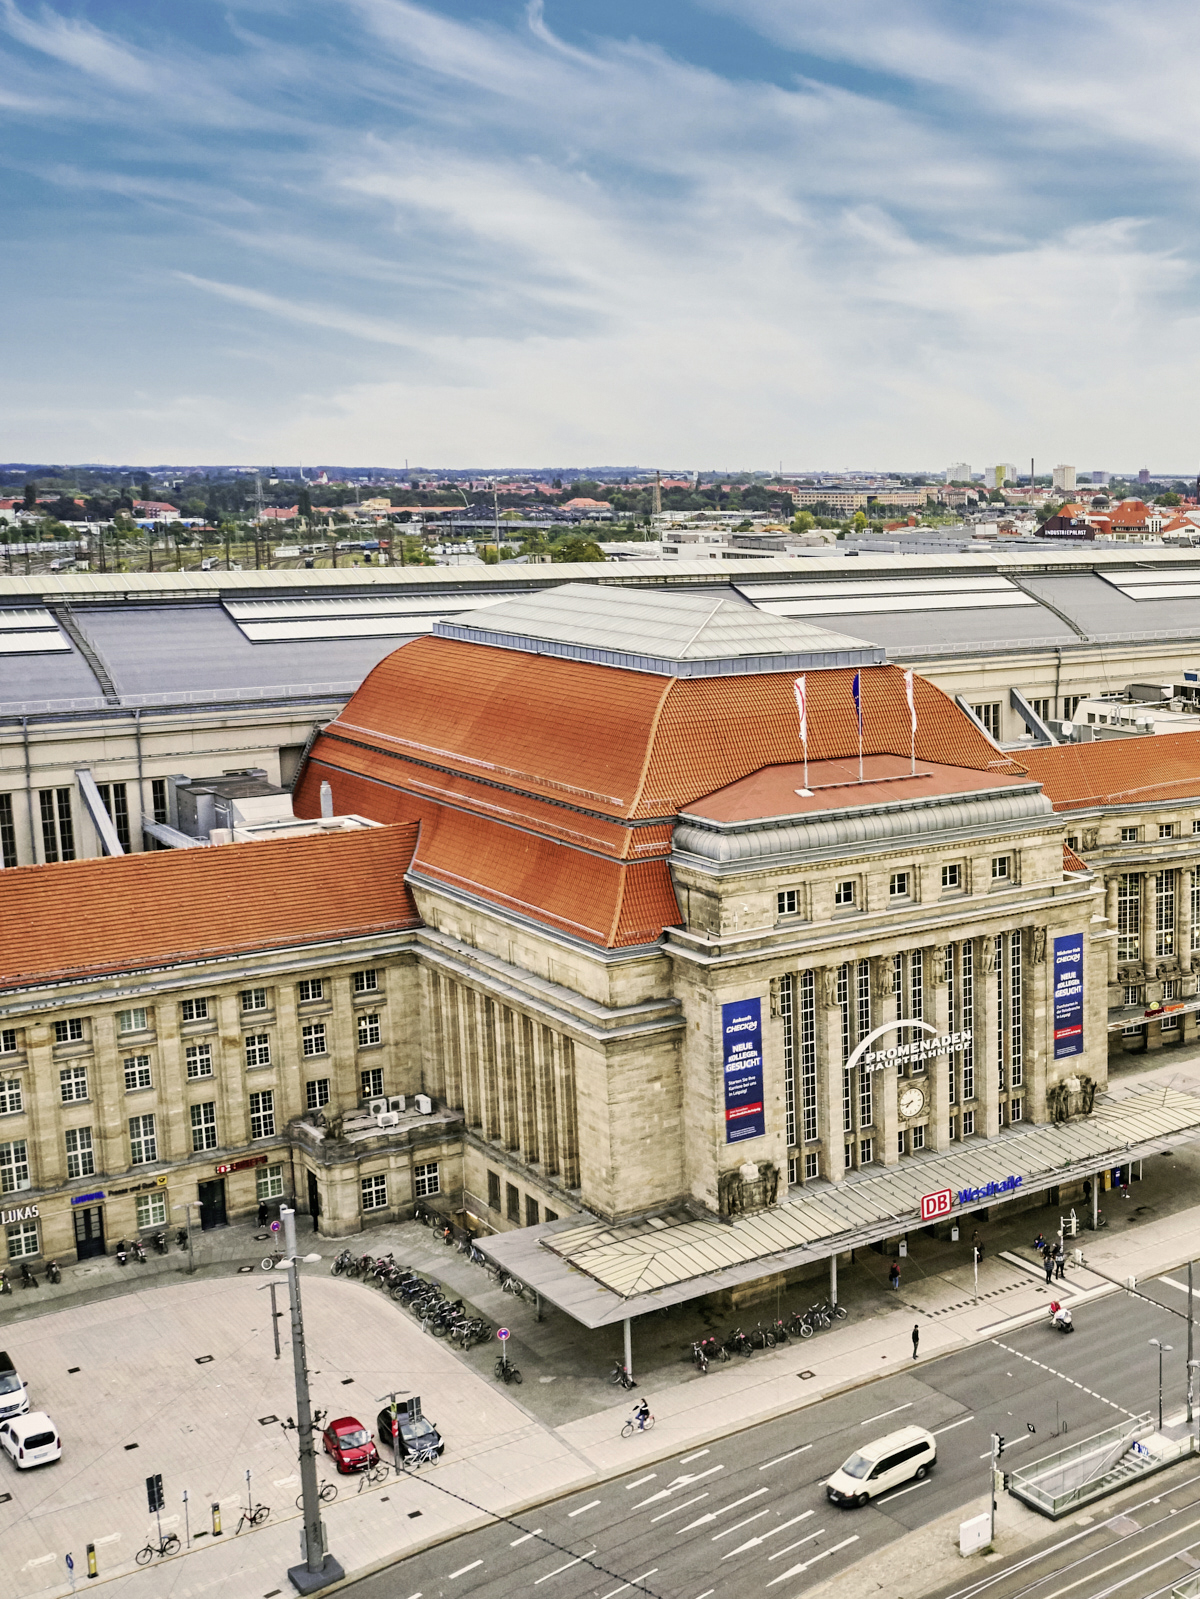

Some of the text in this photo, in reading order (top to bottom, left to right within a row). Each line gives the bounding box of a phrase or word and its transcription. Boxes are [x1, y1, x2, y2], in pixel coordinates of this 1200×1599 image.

[1060, 971, 1076, 981] NEUE
[1055, 985, 1082, 998] GESUCHT
[726, 1021, 757, 1033] CHECK24
[732, 1042, 753, 1053] NEUE
[866, 1030, 972, 1064] PROMENADEN
[726, 1057, 760, 1073] GESUCHT
[866, 1042, 971, 1073] HAUPTBAHNHOF
[925, 1175, 1023, 1216] DB Westhalle
[0, 1204, 40, 1226] LUKAS
